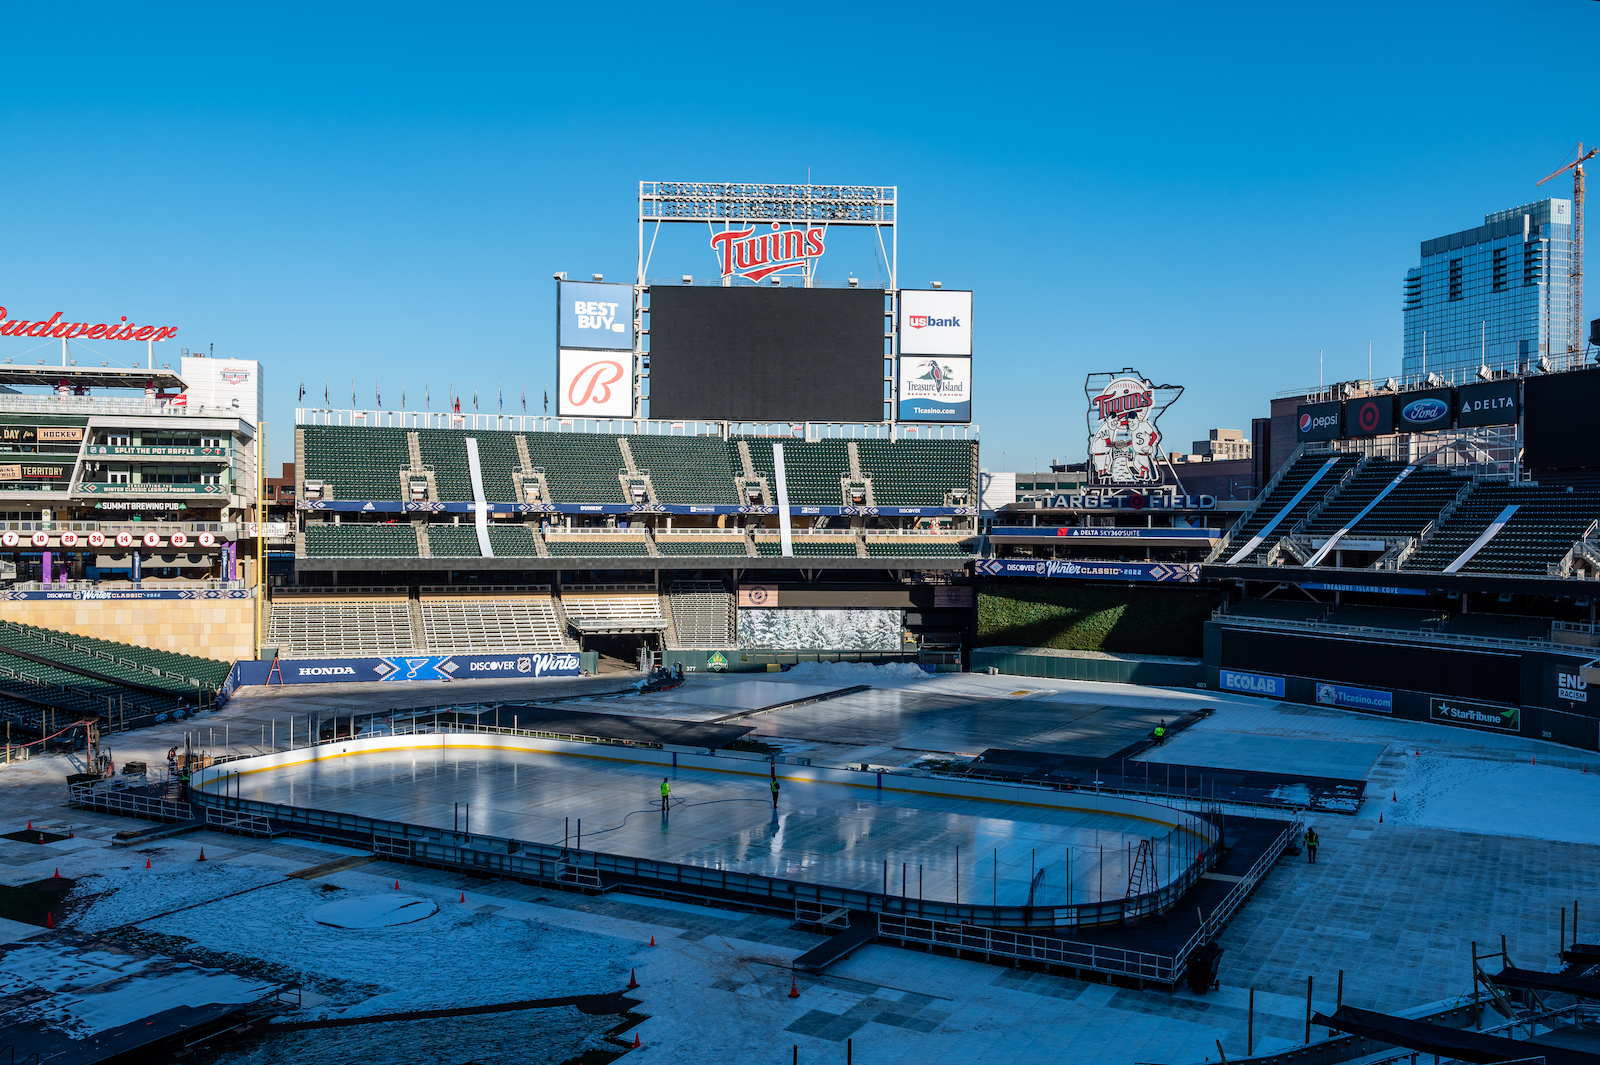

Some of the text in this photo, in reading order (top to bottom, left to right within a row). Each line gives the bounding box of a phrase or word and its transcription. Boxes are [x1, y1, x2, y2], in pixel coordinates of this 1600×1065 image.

[710, 222, 825, 278] Twins
[575, 301, 619, 316] BEST
[578, 315, 615, 330] BUY
[568, 360, 624, 407] B
[907, 381, 963, 392] Treasure Island
[913, 407, 956, 415] TIcasino.com
[1093, 390, 1153, 420] Twins
[1411, 403, 1440, 419] Ford
[1474, 397, 1514, 411] DELTA
[1312, 413, 1338, 429] pepsi
[4, 429, 20, 439] DAY
[23, 431, 35, 439] for
[1136, 432, 1145, 445] S
[23, 467, 63, 476] TERRITORY
[102, 502, 130, 510] SUMMIT
[131, 502, 163, 510] BREWING
[1043, 495, 1215, 509] TARGET FIELD
[1007, 563, 1035, 571] DISCOVER
[1046, 560, 1081, 577] Winter
[1081, 567, 1119, 575] CLASSIC
[82, 590, 111, 600] Winter
[1323, 583, 1353, 591] TREASURE
[1382, 586, 1399, 594] COVE
[299, 666, 356, 675] HONDA
[470, 661, 515, 671] DISCOVER
[1226, 673, 1276, 693] ECOLAB
[1337, 691, 1391, 707] TIcasino.com
[1559, 689, 1586, 699] RACISM
[1450, 707, 1501, 723] StarTribune
[1541, 730, 1552, 738] 365
